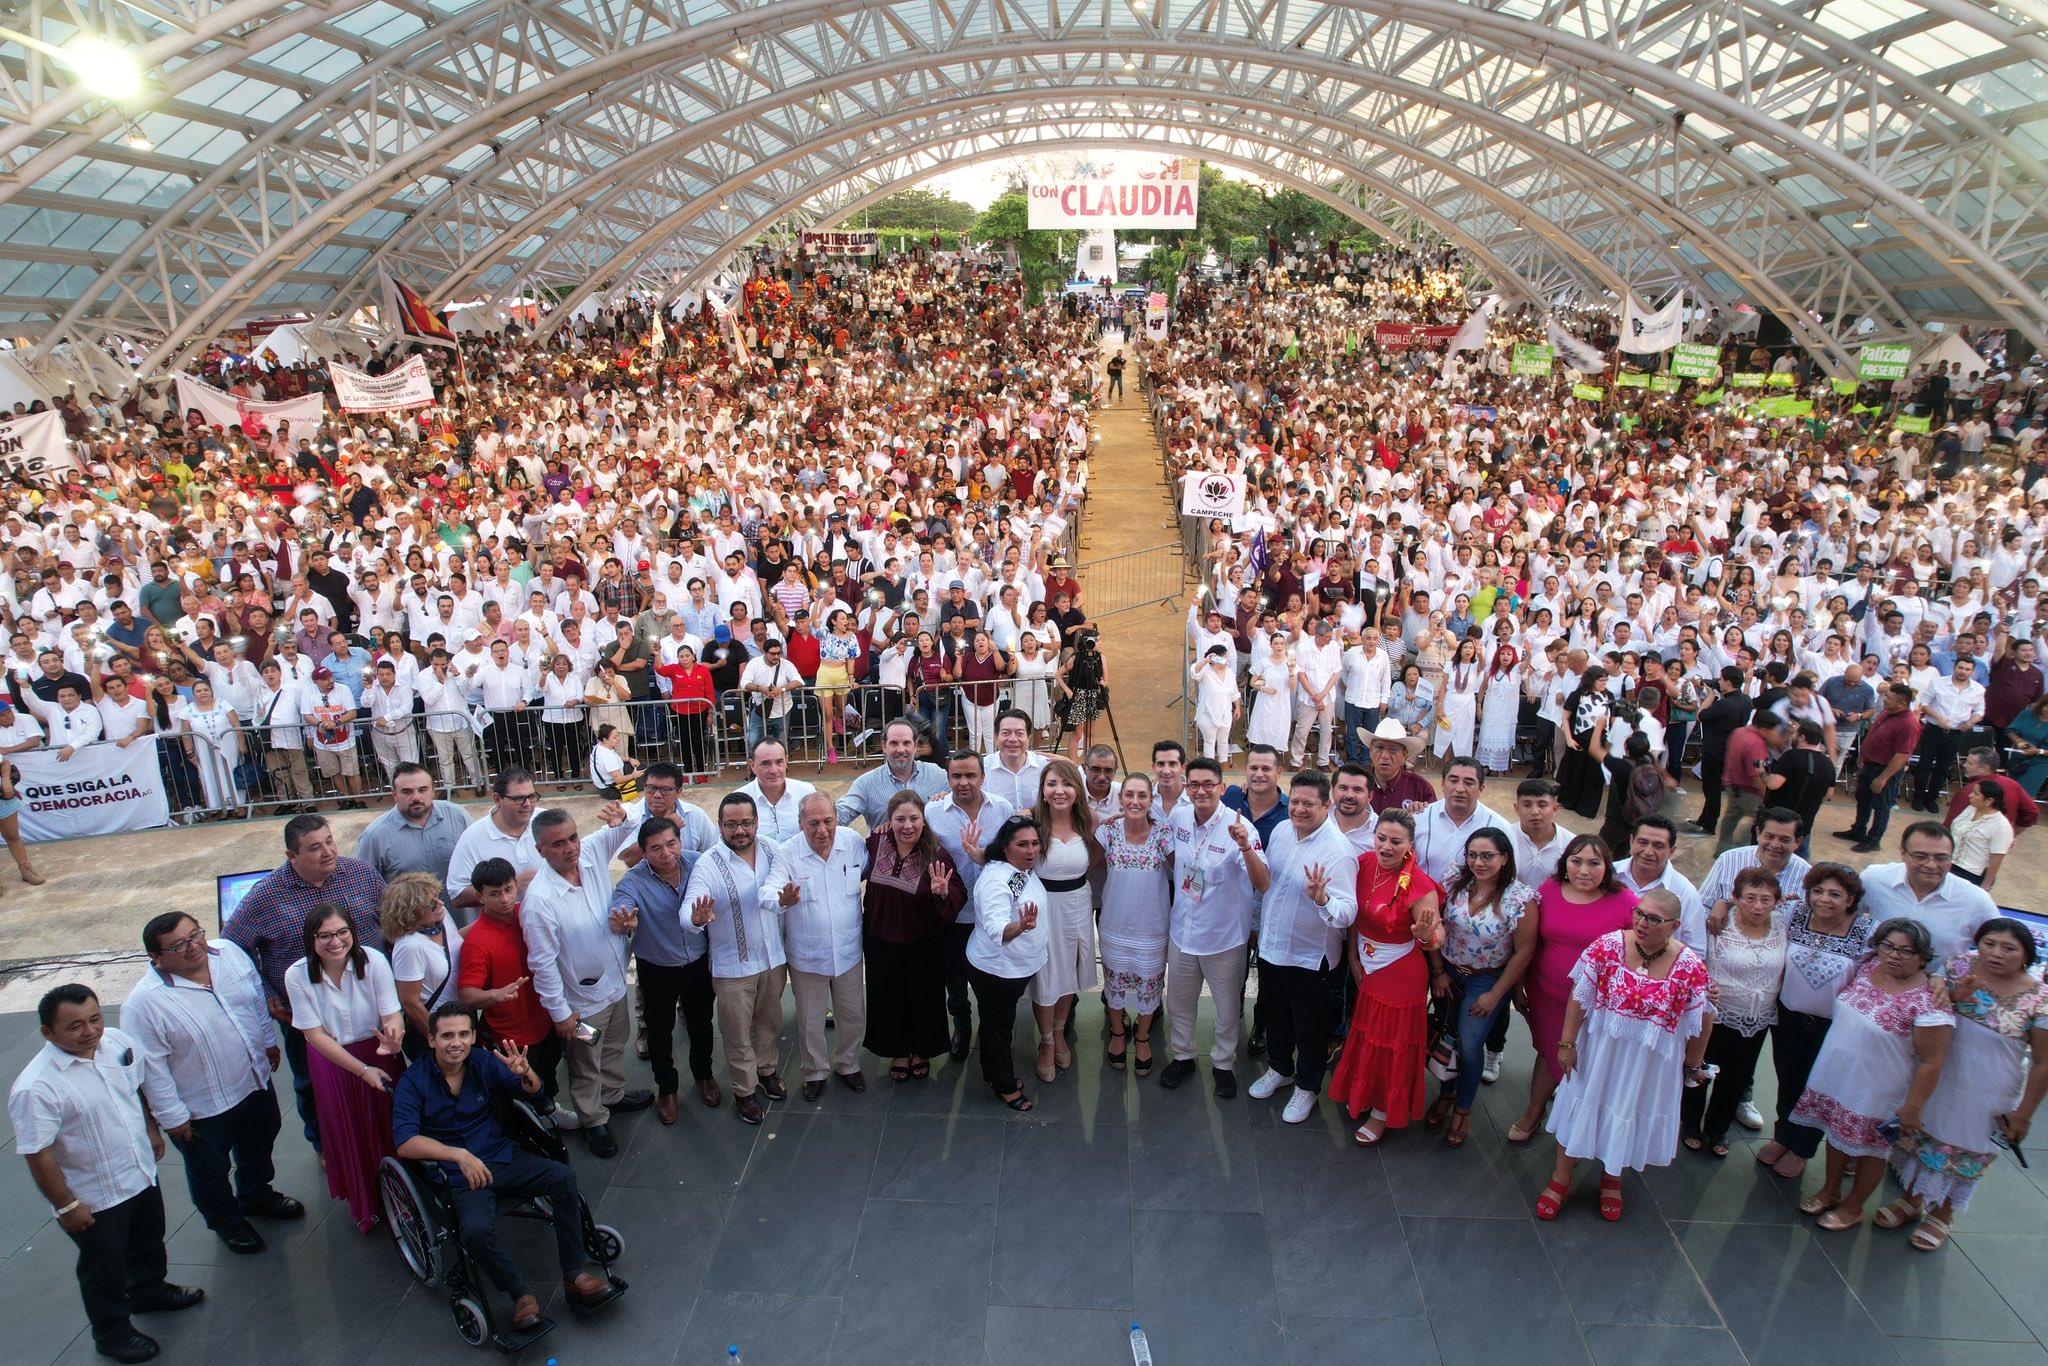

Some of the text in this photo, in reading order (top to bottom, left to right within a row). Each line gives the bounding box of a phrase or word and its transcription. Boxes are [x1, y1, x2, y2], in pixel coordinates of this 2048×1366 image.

[1032, 184, 1195, 216] CON CLAUDIA
[1678, 342, 1719, 357] Claudia
[1860, 344, 1911, 363] Palizada
[1676, 364, 1711, 377] VERDE
[1860, 363, 1906, 378] PRESENTE
[1190, 508, 1235, 519] CAMPECHE
[25, 773, 133, 799] QUE SIGA LA
[29, 787, 142, 812] DEMOCRACIA
